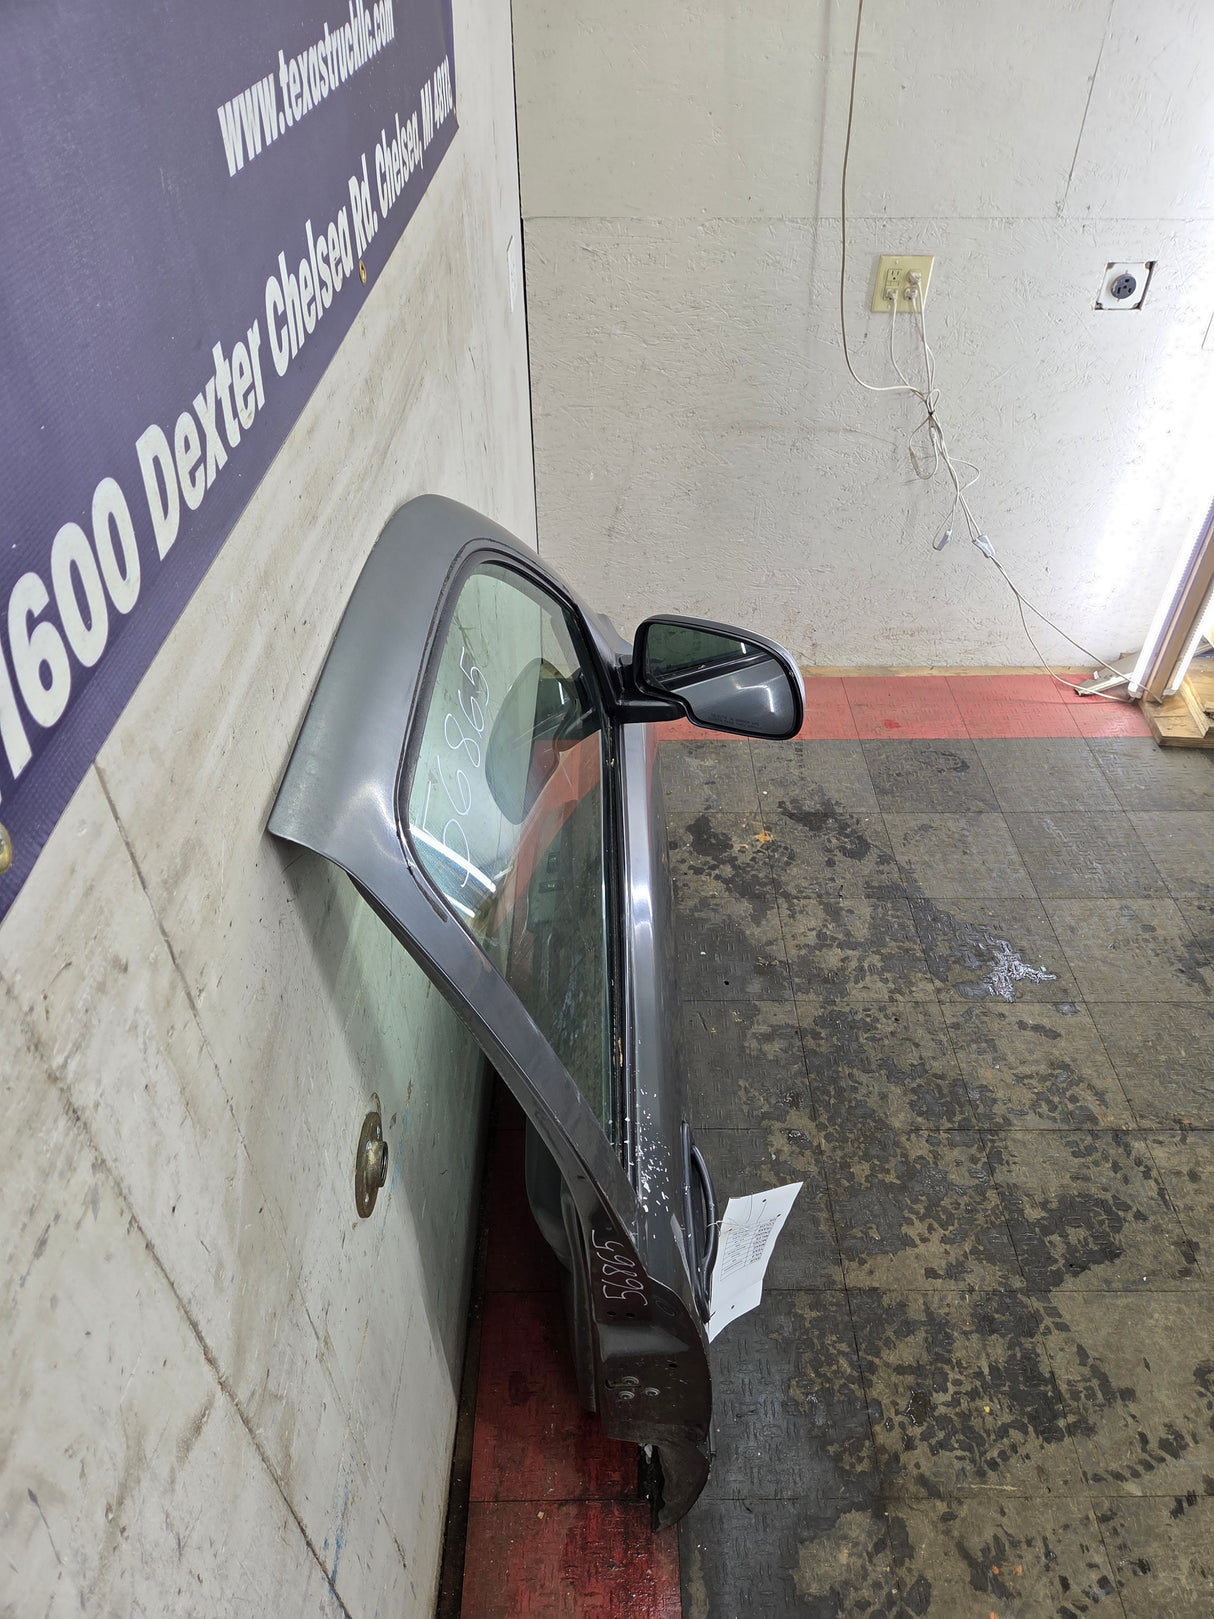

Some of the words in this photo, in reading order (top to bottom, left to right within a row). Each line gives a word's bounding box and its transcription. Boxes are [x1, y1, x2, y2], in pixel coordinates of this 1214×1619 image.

[217, 0, 394, 177] www.texastruckllc.com
[136, 319, 265, 561] Dexter
[265, 206, 354, 377] Chelsea
[348, 153, 378, 259] Rd.
[375, 110, 423, 219] Chelsea,
[420, 80, 434, 151] MI
[421, 647, 489, 887] 56865
[591, 1229, 648, 1306] 56865
